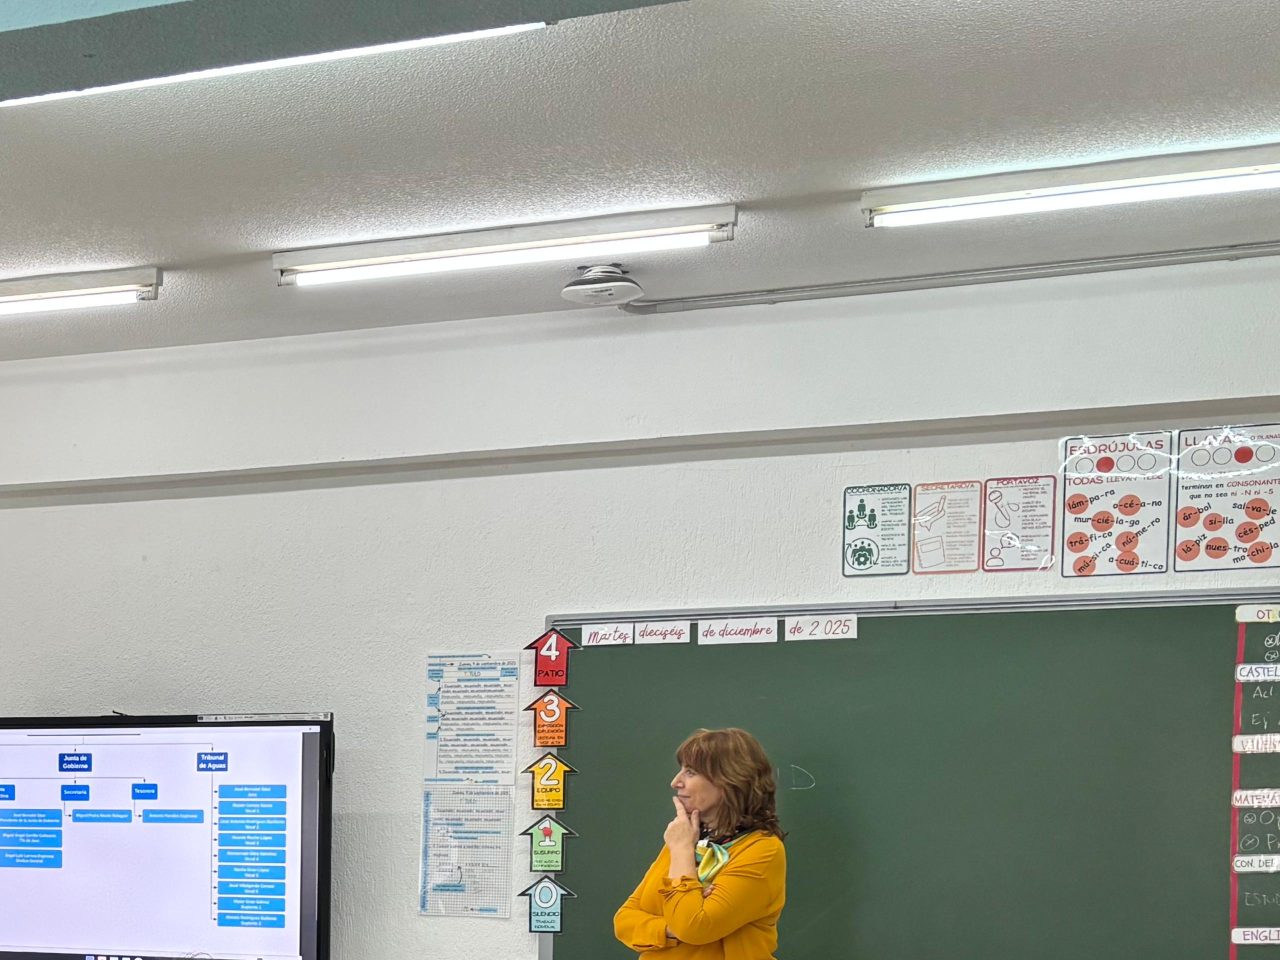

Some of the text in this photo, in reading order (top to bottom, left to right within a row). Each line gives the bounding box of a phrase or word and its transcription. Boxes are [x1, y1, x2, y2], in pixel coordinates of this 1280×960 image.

[1066, 476, 1103, 486] TODAS
[1189, 492, 1201, 500] que
[1182, 502, 1212, 521] ár-bol
[1238, 516, 1276, 538] cés-ped
[702, 624, 773, 638] de diciembre
[789, 624, 803, 636] de
[540, 633, 560, 661] 4
[538, 669, 564, 678] PATIO
[539, 694, 561, 723] 3
[207, 762, 226, 770] Aguas
[538, 757, 559, 785] 2
[534, 880, 558, 908] 0
